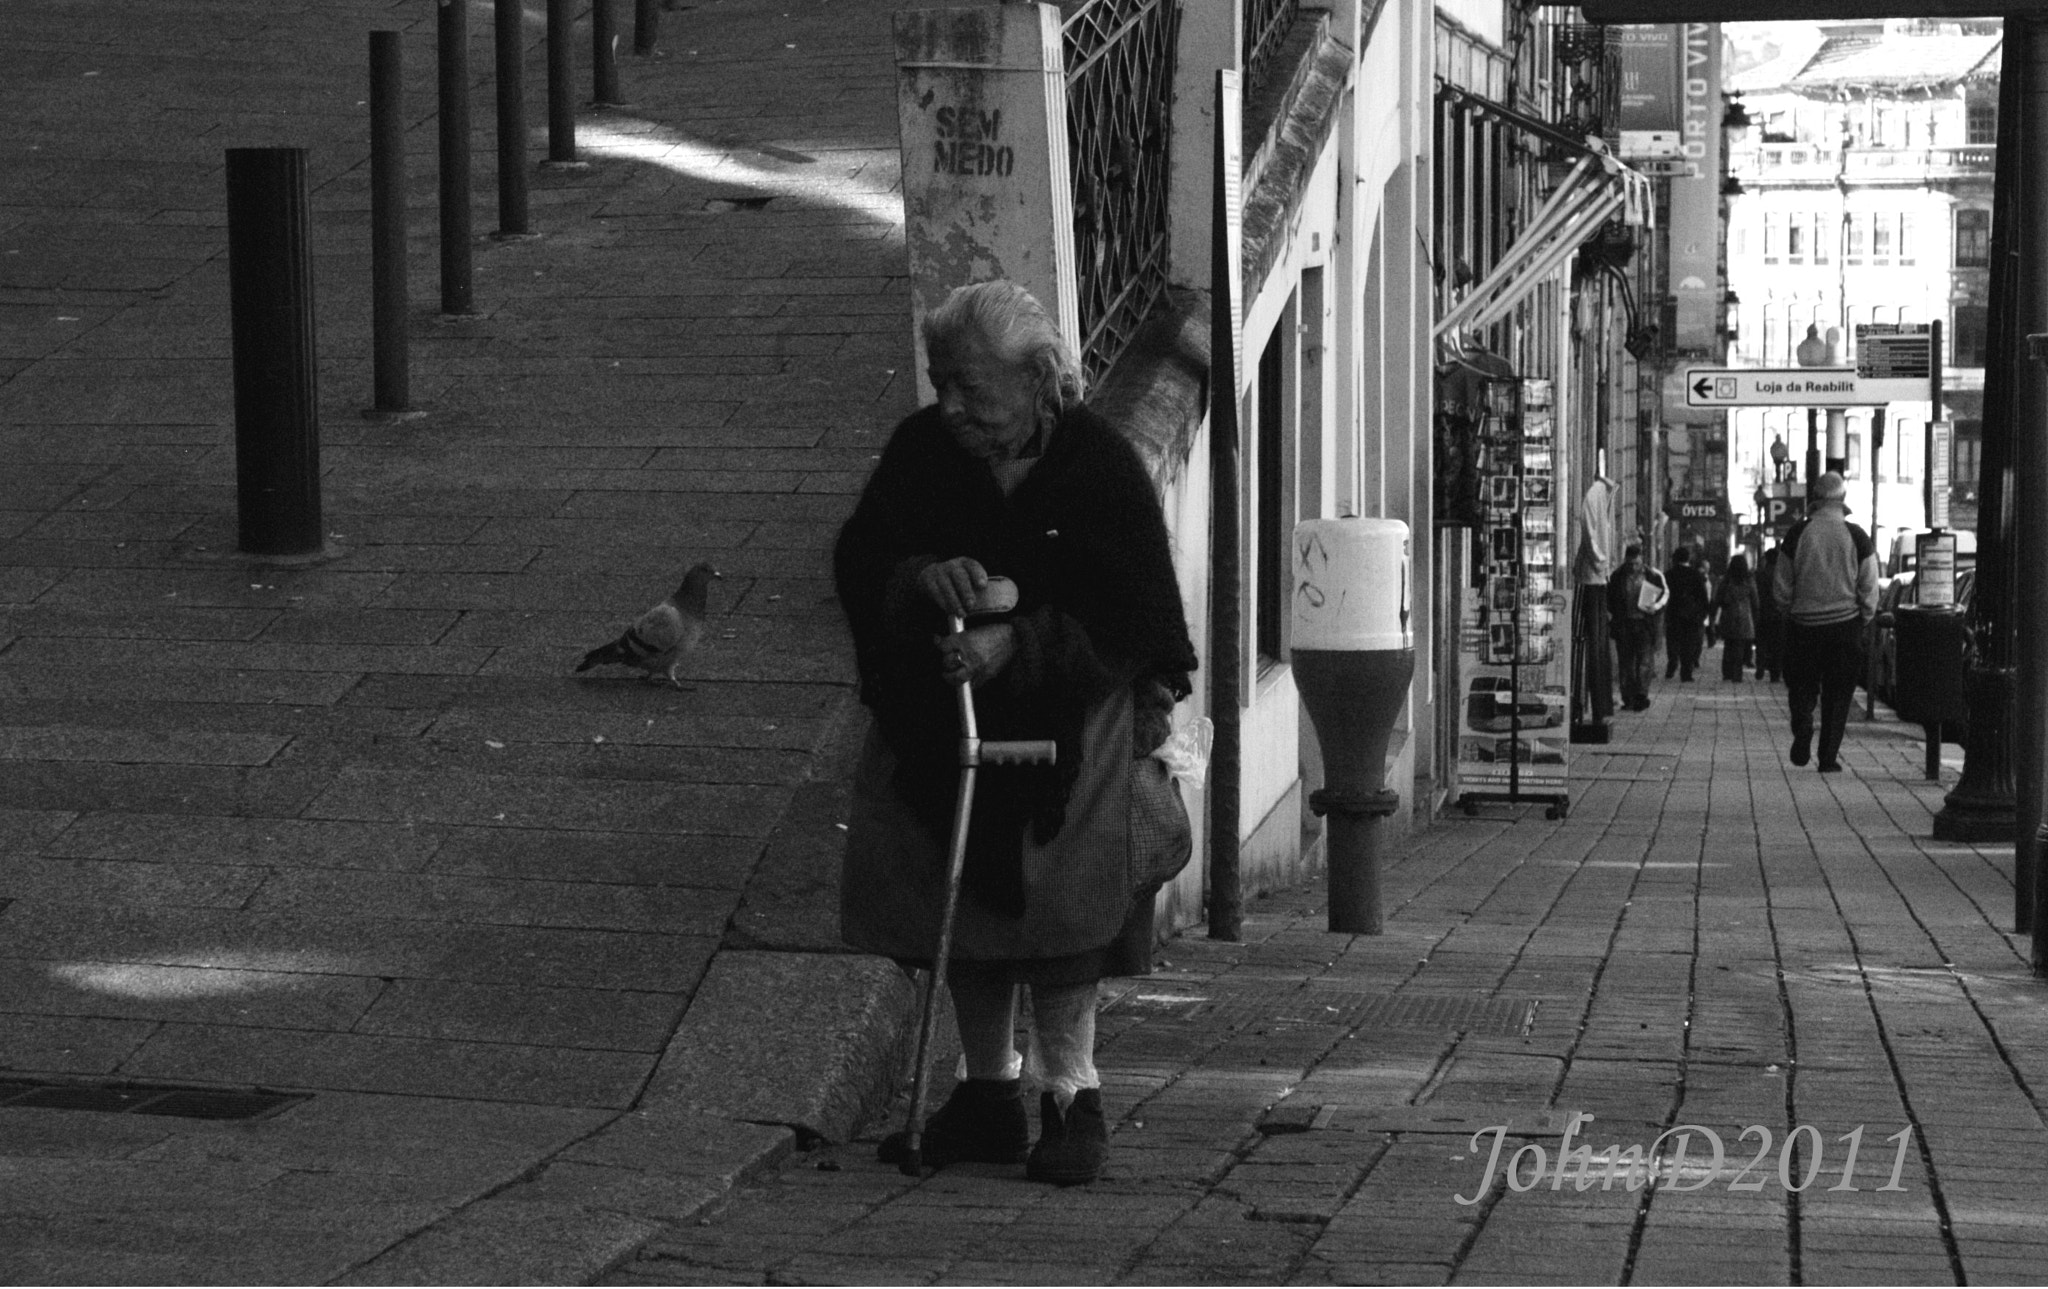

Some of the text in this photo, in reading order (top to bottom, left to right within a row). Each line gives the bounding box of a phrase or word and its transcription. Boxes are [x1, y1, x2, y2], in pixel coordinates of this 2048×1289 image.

[934, 140, 1014, 177] MEDO
[1755, 381, 1855, 395] Loja da Reabilit
[1769, 500, 1787, 523] P
